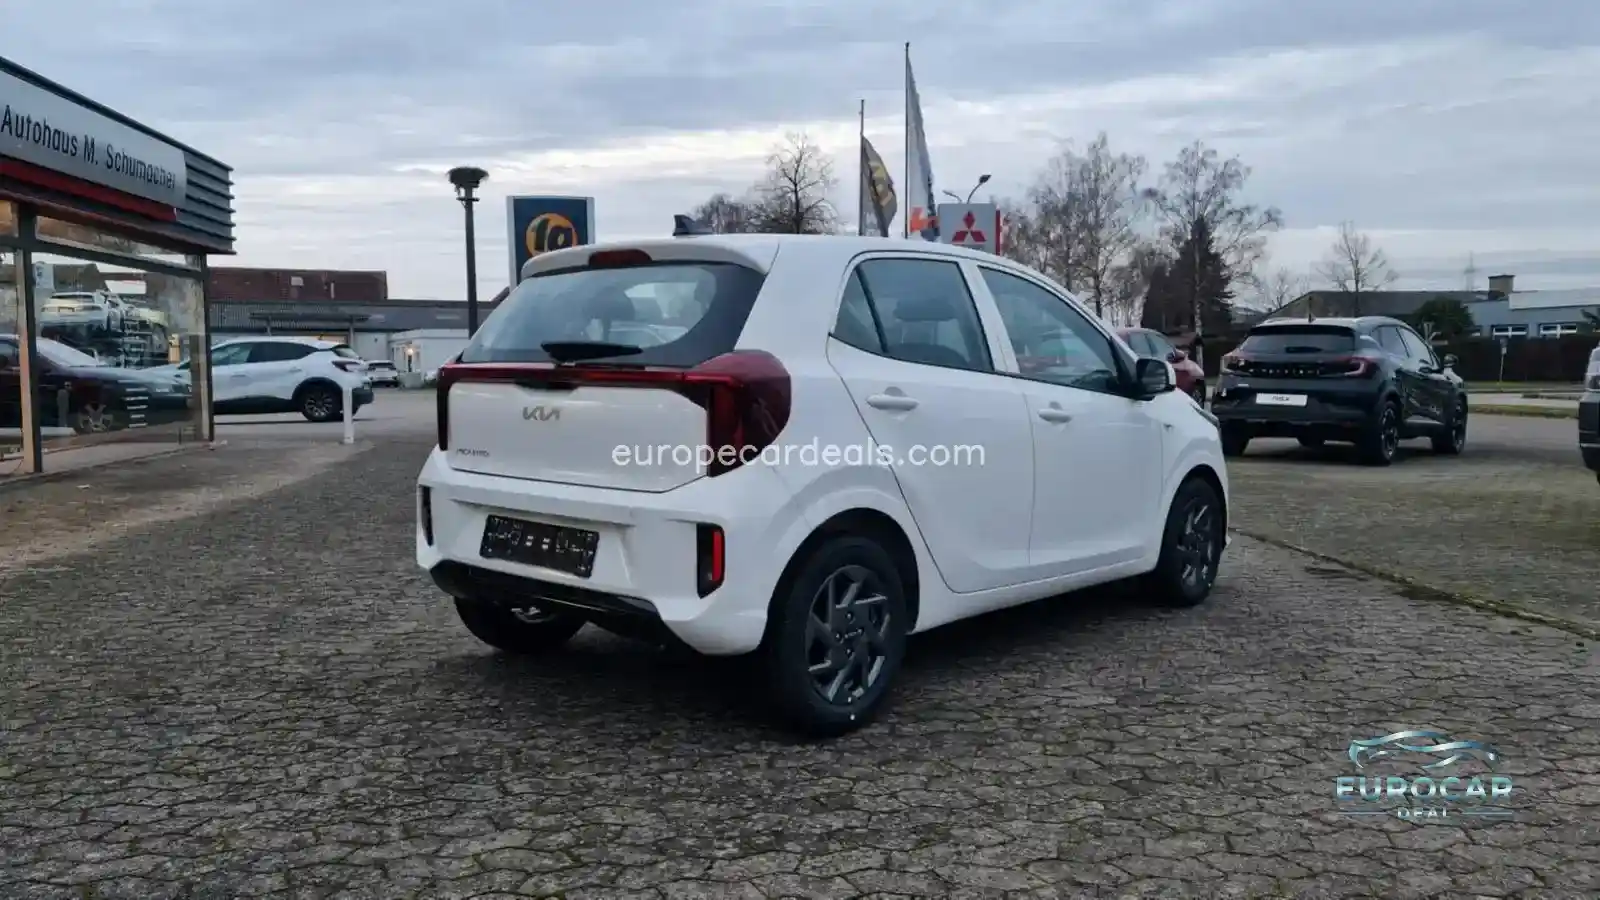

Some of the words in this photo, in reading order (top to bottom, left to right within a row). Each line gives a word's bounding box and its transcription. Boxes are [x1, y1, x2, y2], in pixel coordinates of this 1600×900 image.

[1, 105, 78, 157] Autohaus
[84, 134, 98, 165] M.
[106, 144, 176, 189] Schumacher
[522, 406, 560, 421] KIA
